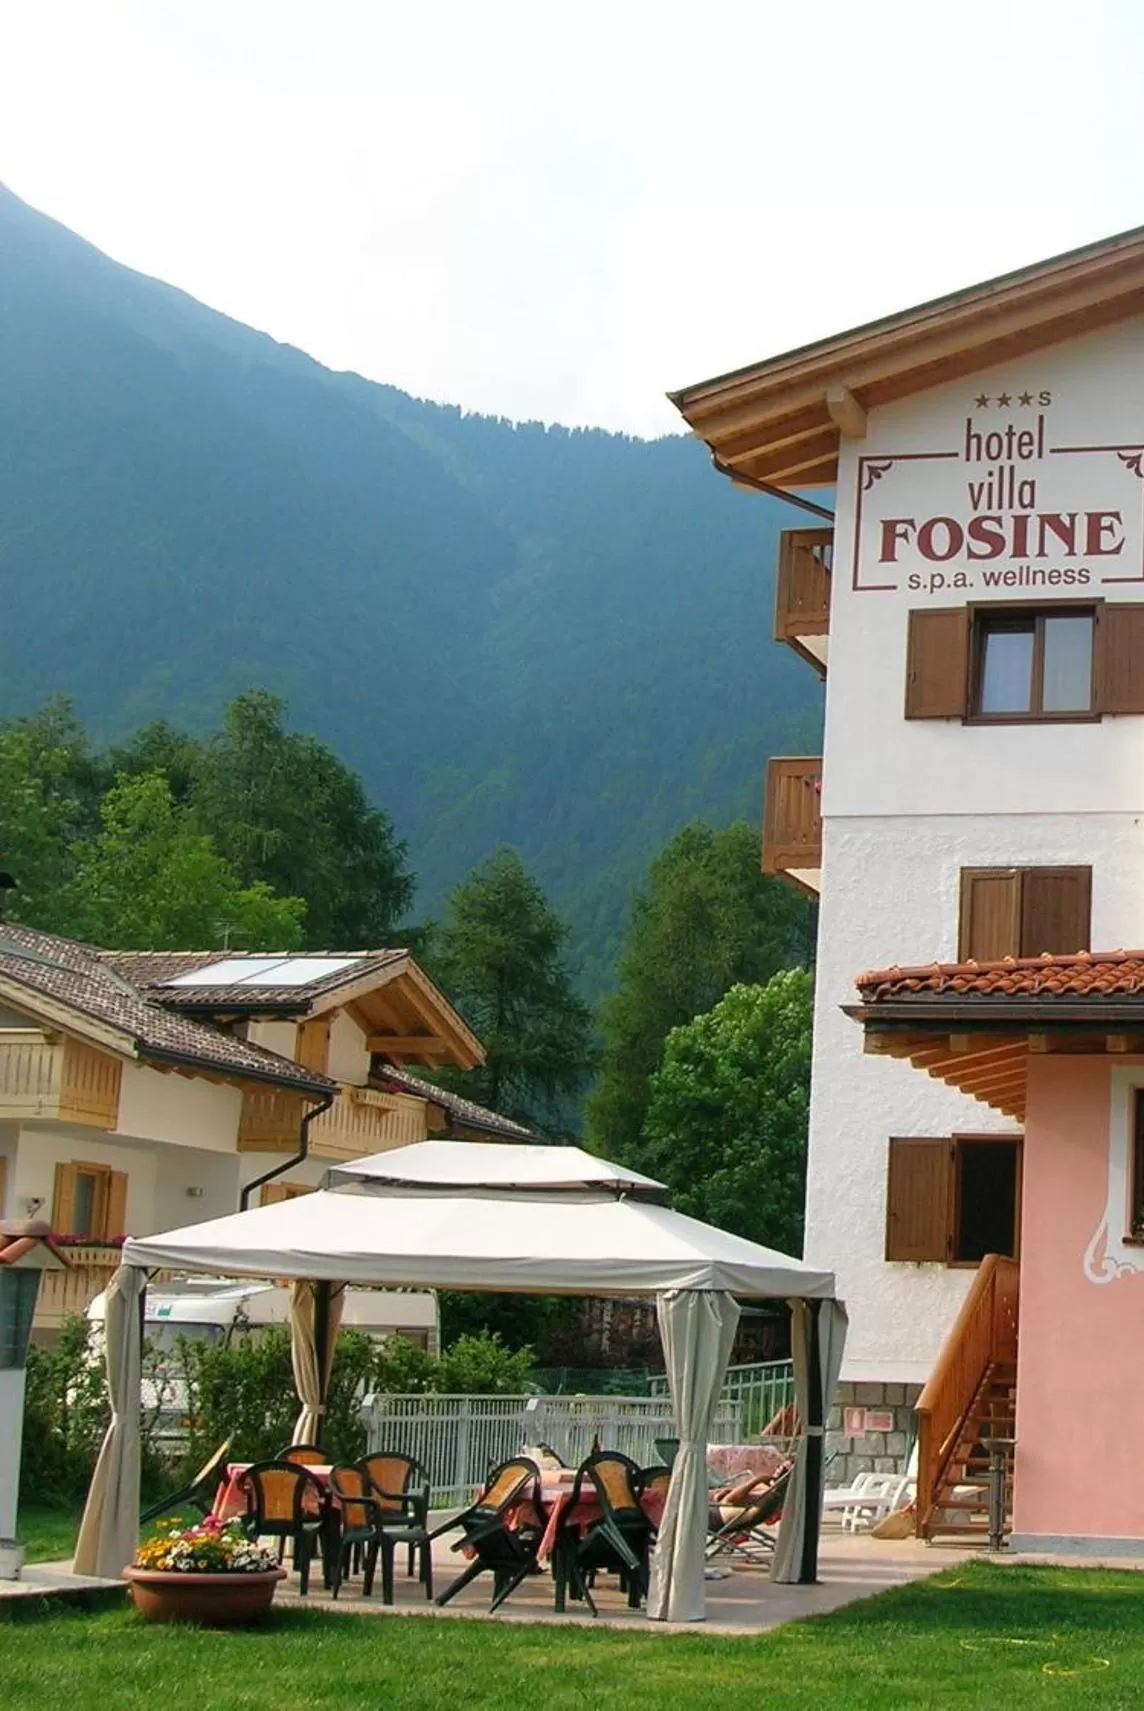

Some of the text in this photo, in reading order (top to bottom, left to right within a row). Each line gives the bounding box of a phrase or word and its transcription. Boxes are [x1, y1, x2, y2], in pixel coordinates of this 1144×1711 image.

[965, 413, 1045, 462] hotel
[967, 464, 1036, 511] villa
[877, 510, 1126, 563] FOSINE
[907, 565, 1091, 594] s.p.a. wellness
